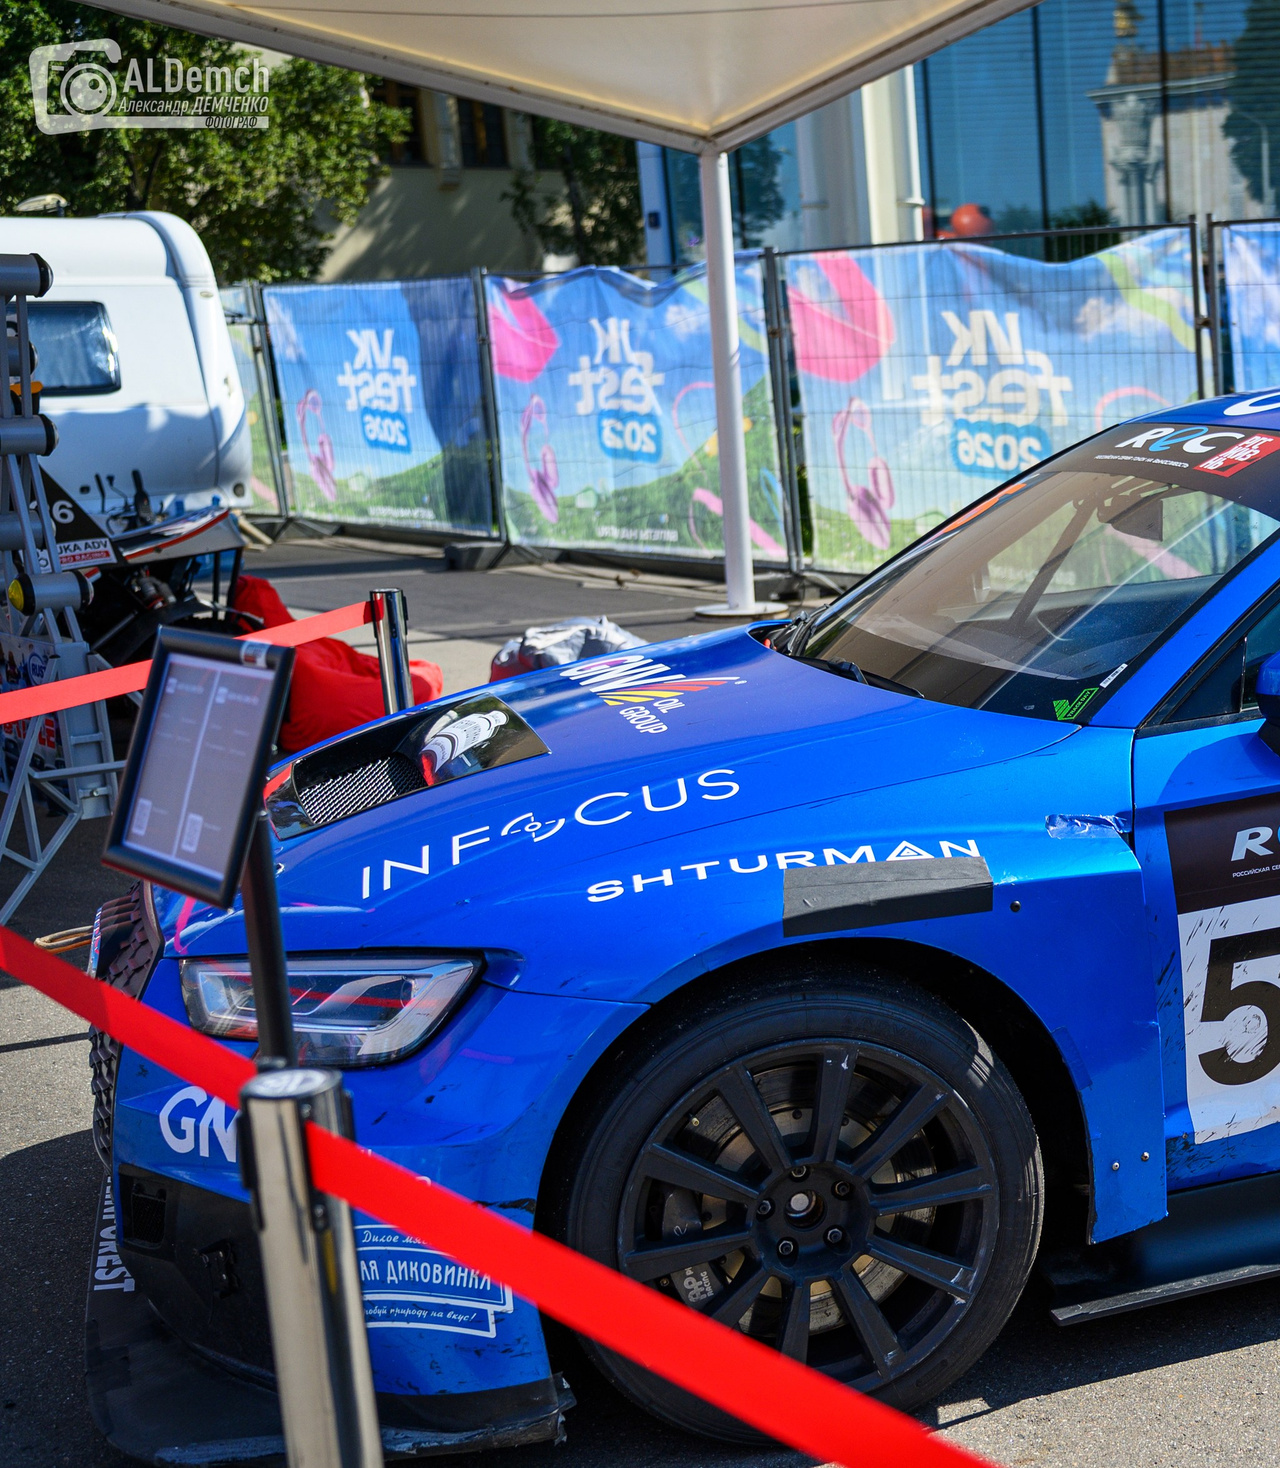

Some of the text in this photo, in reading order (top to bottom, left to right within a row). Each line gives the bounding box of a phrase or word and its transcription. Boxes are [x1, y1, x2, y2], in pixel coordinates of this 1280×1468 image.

[560, 655, 686, 693] GNV
[619, 705, 668, 734] GROUP
[653, 698, 685, 714] OIL
[1232, 866, 1270, 878] РОССИЙСКАЯ
[159, 1086, 239, 1163] GN
[387, 1260, 491, 1290] ДИКОВИНКА
[430, 1310, 444, 1318] на
[446, 1312, 477, 1323] вкус!
